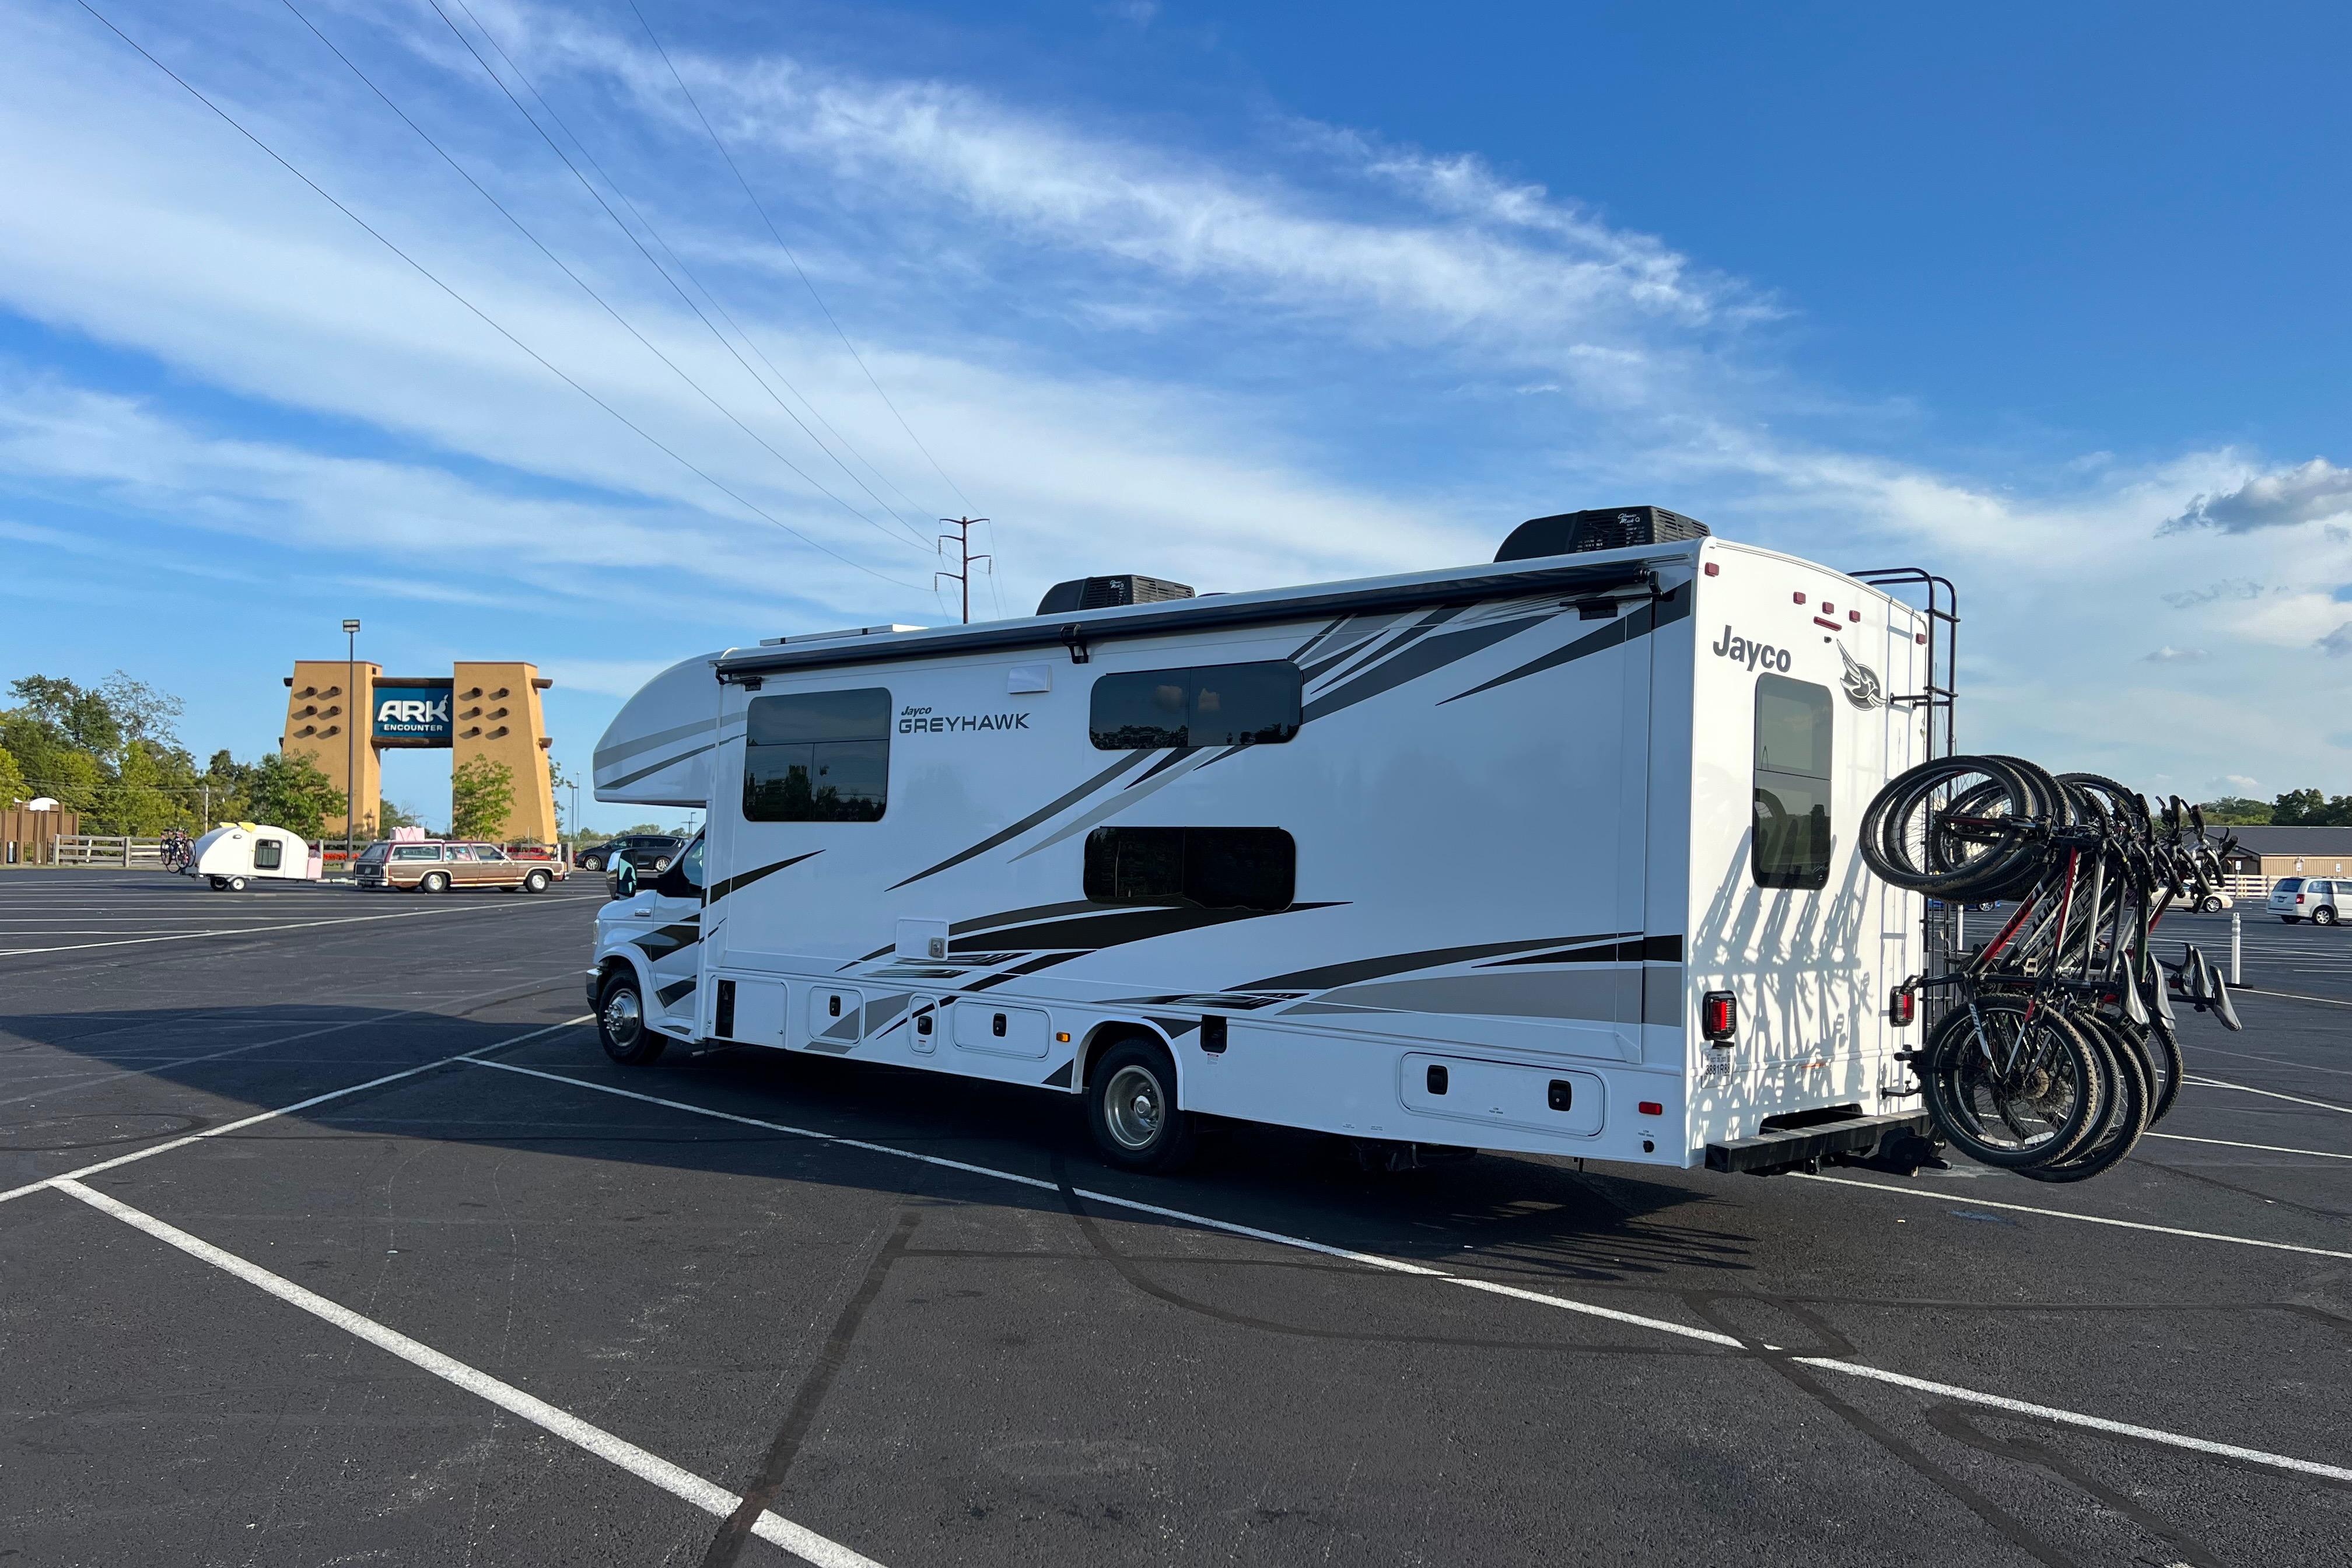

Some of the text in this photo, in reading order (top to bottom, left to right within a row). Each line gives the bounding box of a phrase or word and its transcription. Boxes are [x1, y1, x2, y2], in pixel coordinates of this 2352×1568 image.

[1713, 624, 1791, 673] Jayco
[377, 694, 449, 723] ARK
[901, 706, 932, 717] Jayco
[384, 724, 443, 732] ENCOUNTER
[899, 713, 1031, 734] GREYHAWK
